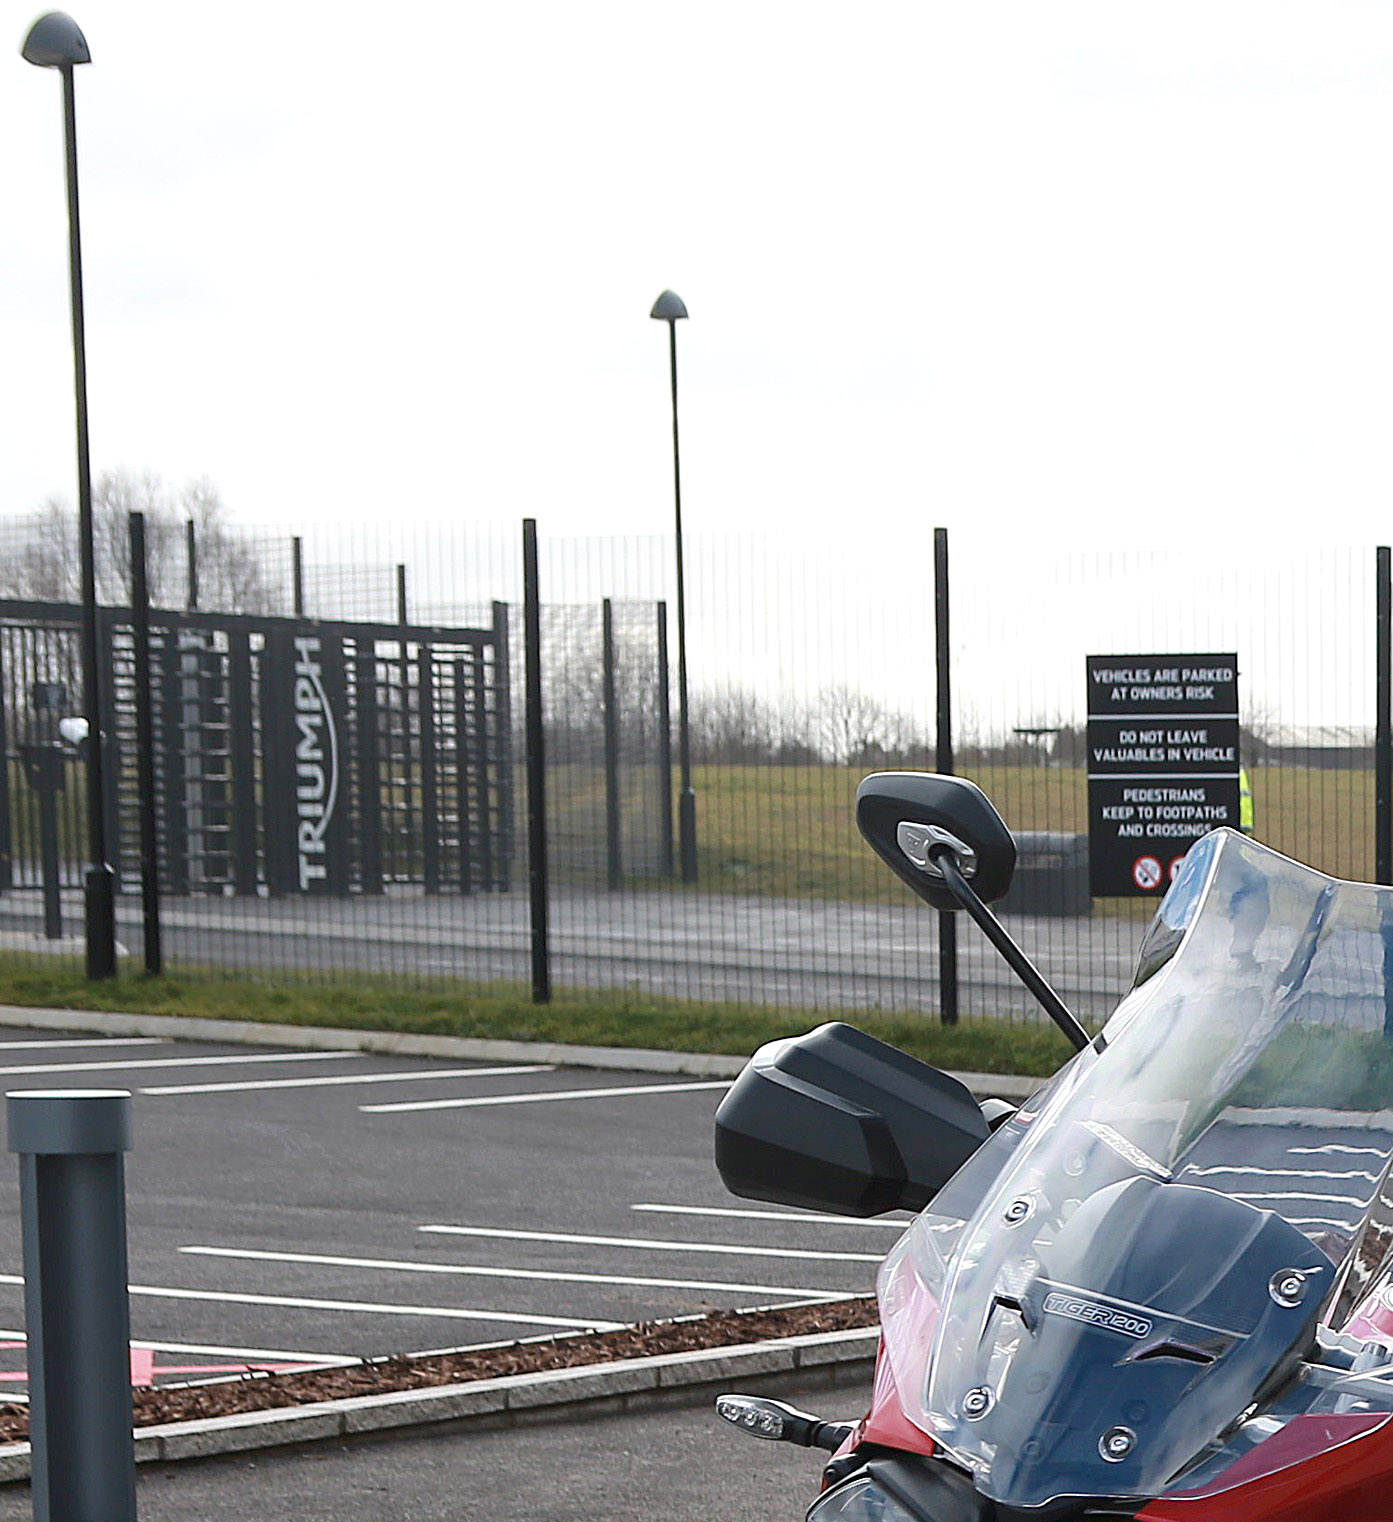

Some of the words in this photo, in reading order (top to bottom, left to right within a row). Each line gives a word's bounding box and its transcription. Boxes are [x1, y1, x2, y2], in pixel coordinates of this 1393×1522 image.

[1093, 669, 1151, 684] VEHICLES
[1154, 669, 1180, 683] ARE
[1182, 668, 1234, 683] PARKED
[1111, 686, 1128, 701] AT
[1130, 686, 1184, 701] OWNERS
[1186, 686, 1215, 700] RISK
[1119, 730, 1136, 745] DO
[1139, 730, 1164, 745] NOT
[1167, 730, 1208, 745] LEAVE
[1093, 748, 1166, 763] VALUABLES
[1168, 748, 1182, 762] IN
[1185, 747, 1235, 762] VEHICLE
[294, 637, 338, 890] TRIUMPH
[1123, 788, 1206, 802] PEDESTRIANS
[1102, 806, 1135, 820] KEEP
[1137, 806, 1154, 820] TO
[1156, 805, 1228, 820] FOOTPATHS
[1118, 824, 1143, 838] AND
